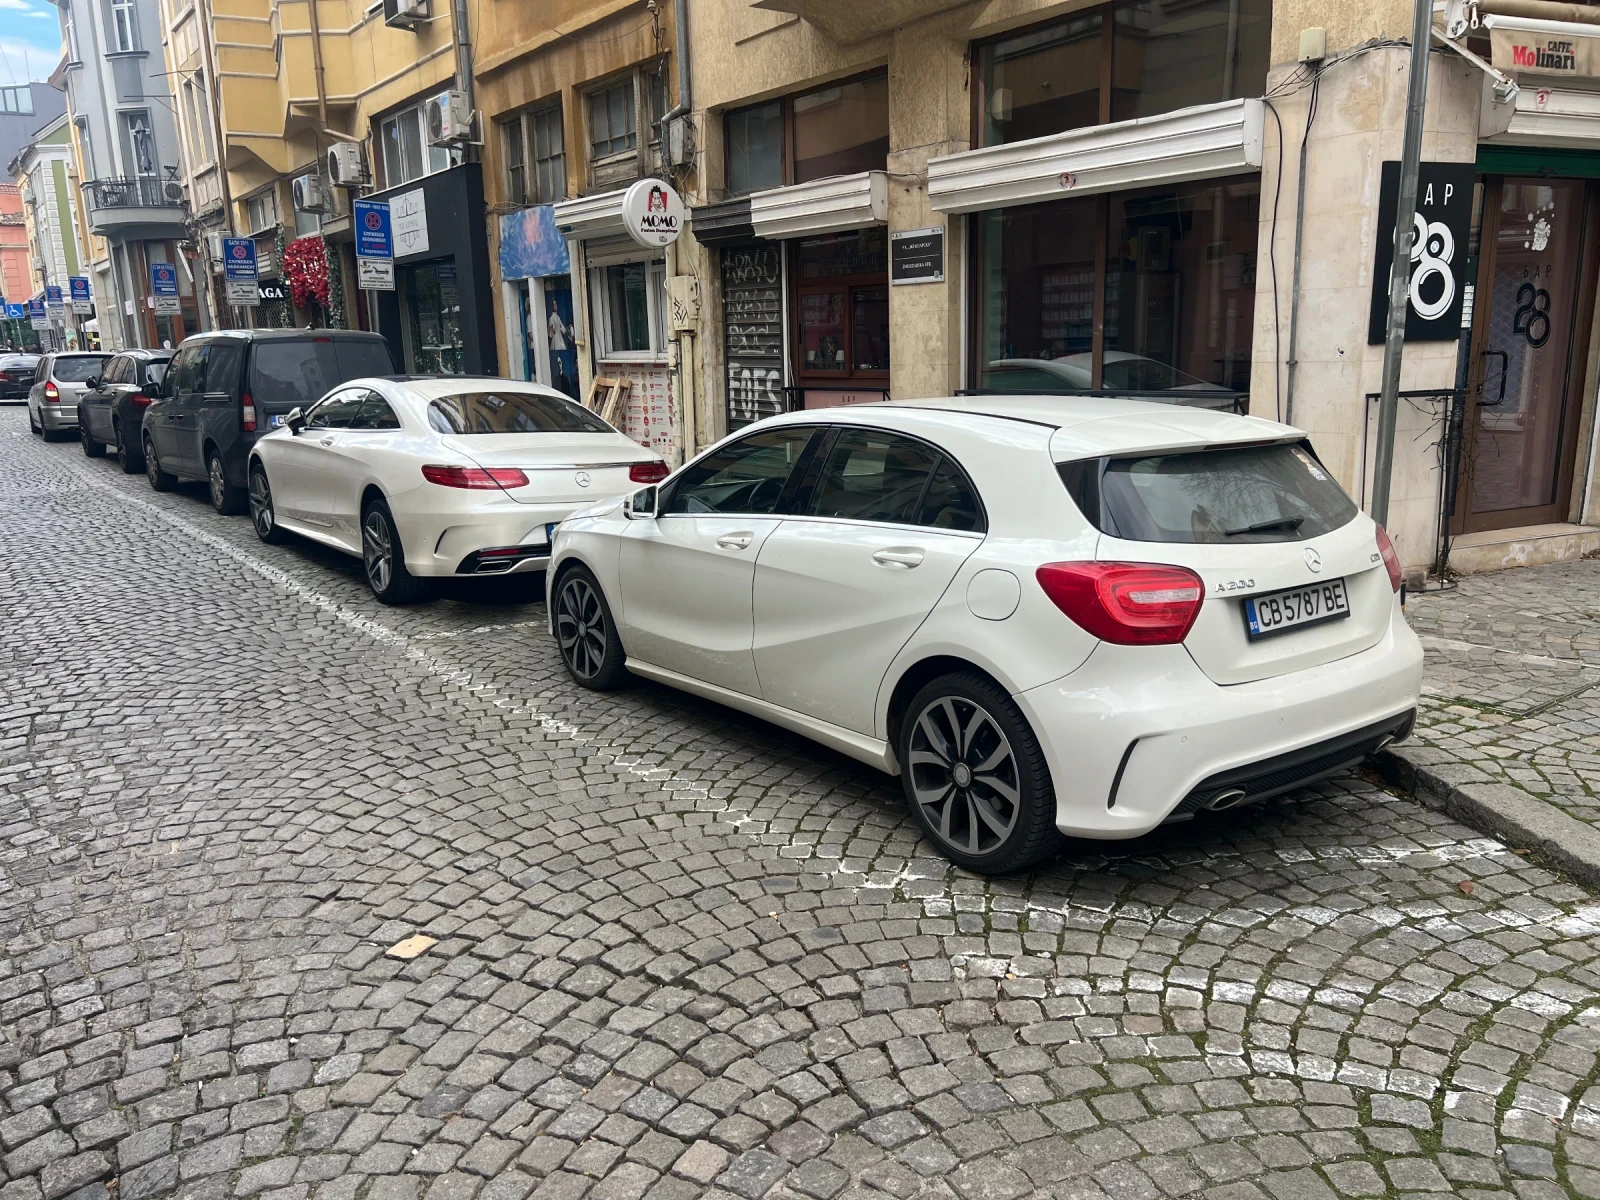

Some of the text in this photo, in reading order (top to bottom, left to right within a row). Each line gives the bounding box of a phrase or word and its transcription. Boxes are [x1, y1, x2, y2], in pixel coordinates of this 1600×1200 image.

[1512, 45, 1575, 70] Molinari
[1424, 183, 1454, 205] АР
[640, 215, 678, 228] MOMO
[1524, 264, 1551, 278] БАР
[1513, 282, 1550, 348] 28
[1215, 579, 1255, 592] A 200
[1250, 620, 1258, 630] BG
